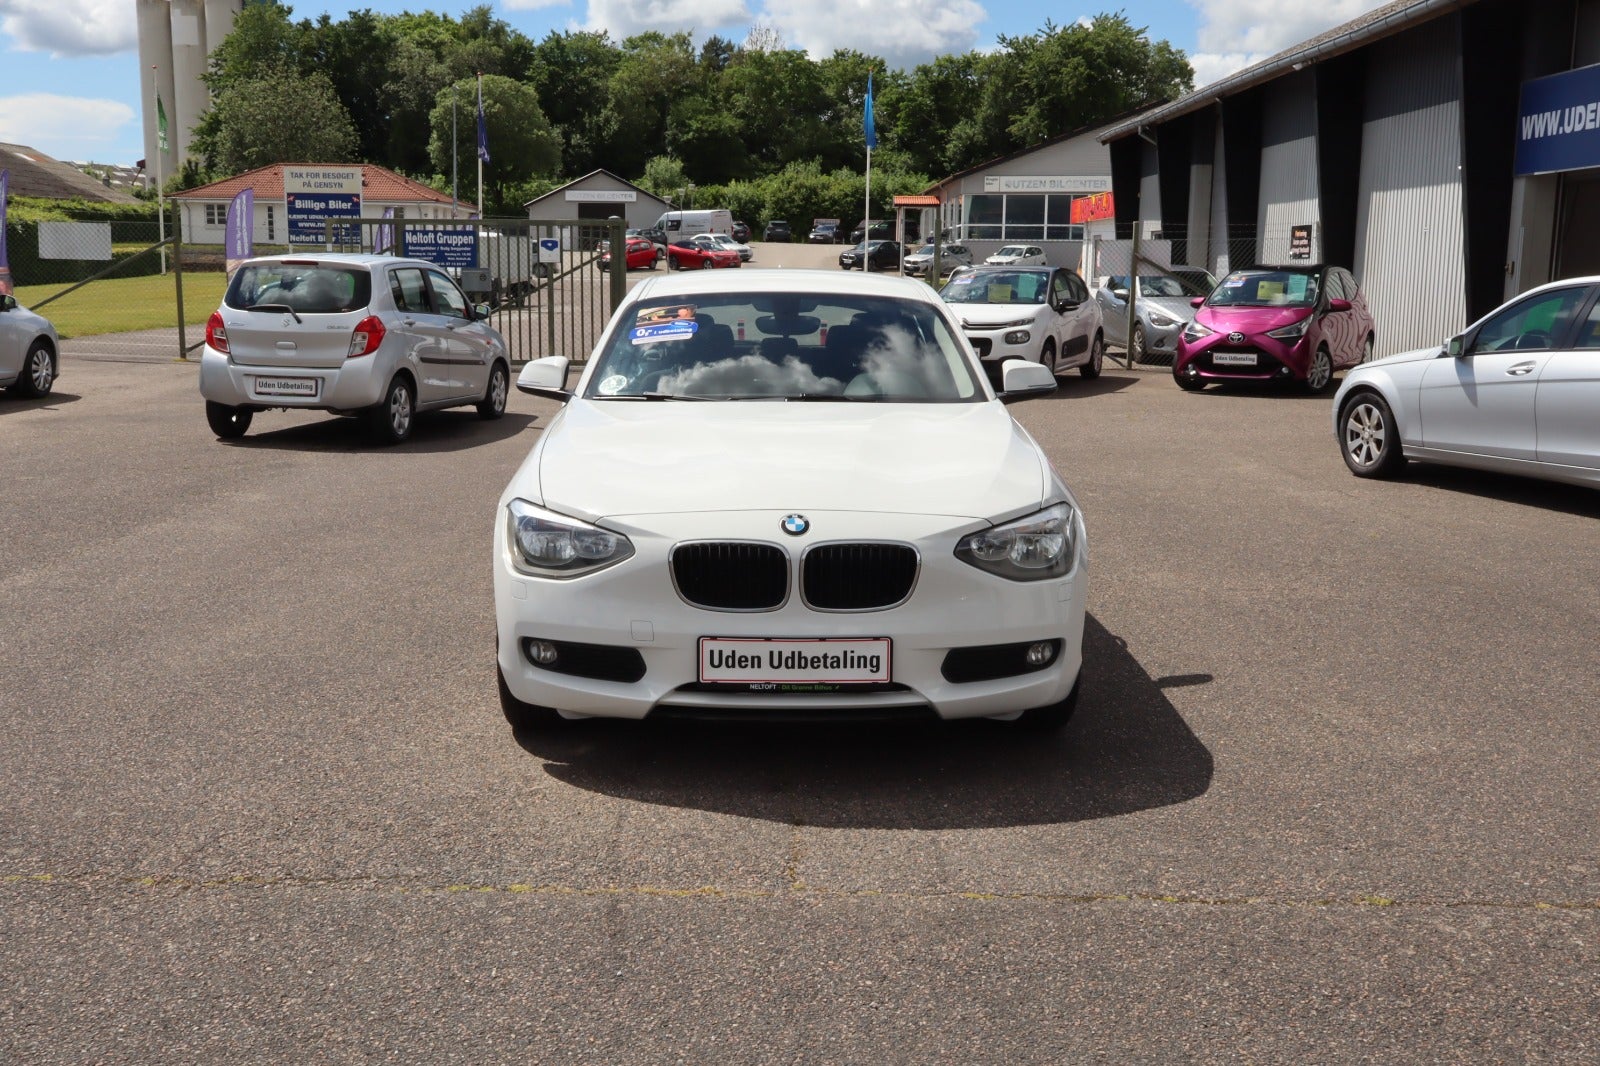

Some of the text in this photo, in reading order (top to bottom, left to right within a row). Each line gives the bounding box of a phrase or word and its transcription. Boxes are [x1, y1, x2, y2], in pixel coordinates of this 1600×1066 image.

[1522, 102, 1600, 140] WWW.UDE
[295, 200, 352, 210] Billige Biler
[289, 234, 316, 242] Neltoft
[405, 231, 474, 246] Neltoft Gruppen
[258, 380, 314, 391] Uden Udbetaling
[709, 649, 881, 674] Uden Udbetaling
